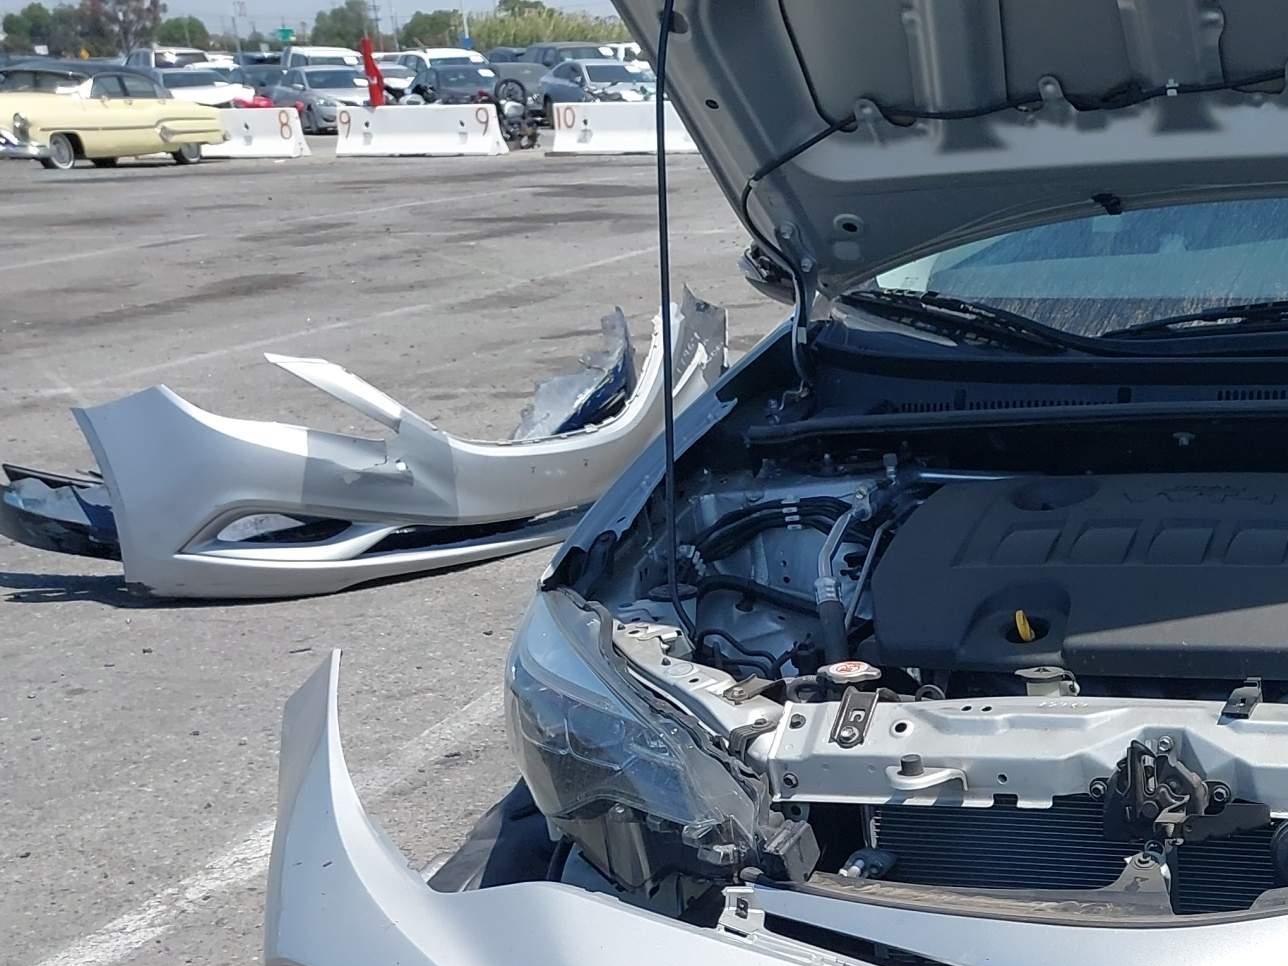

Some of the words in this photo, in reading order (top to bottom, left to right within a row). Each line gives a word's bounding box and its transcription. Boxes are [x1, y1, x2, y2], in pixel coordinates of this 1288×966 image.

[279, 110, 292, 140] 8
[339, 110, 352, 139] 9
[475, 107, 489, 137] 9
[556, 106, 576, 129] 10
